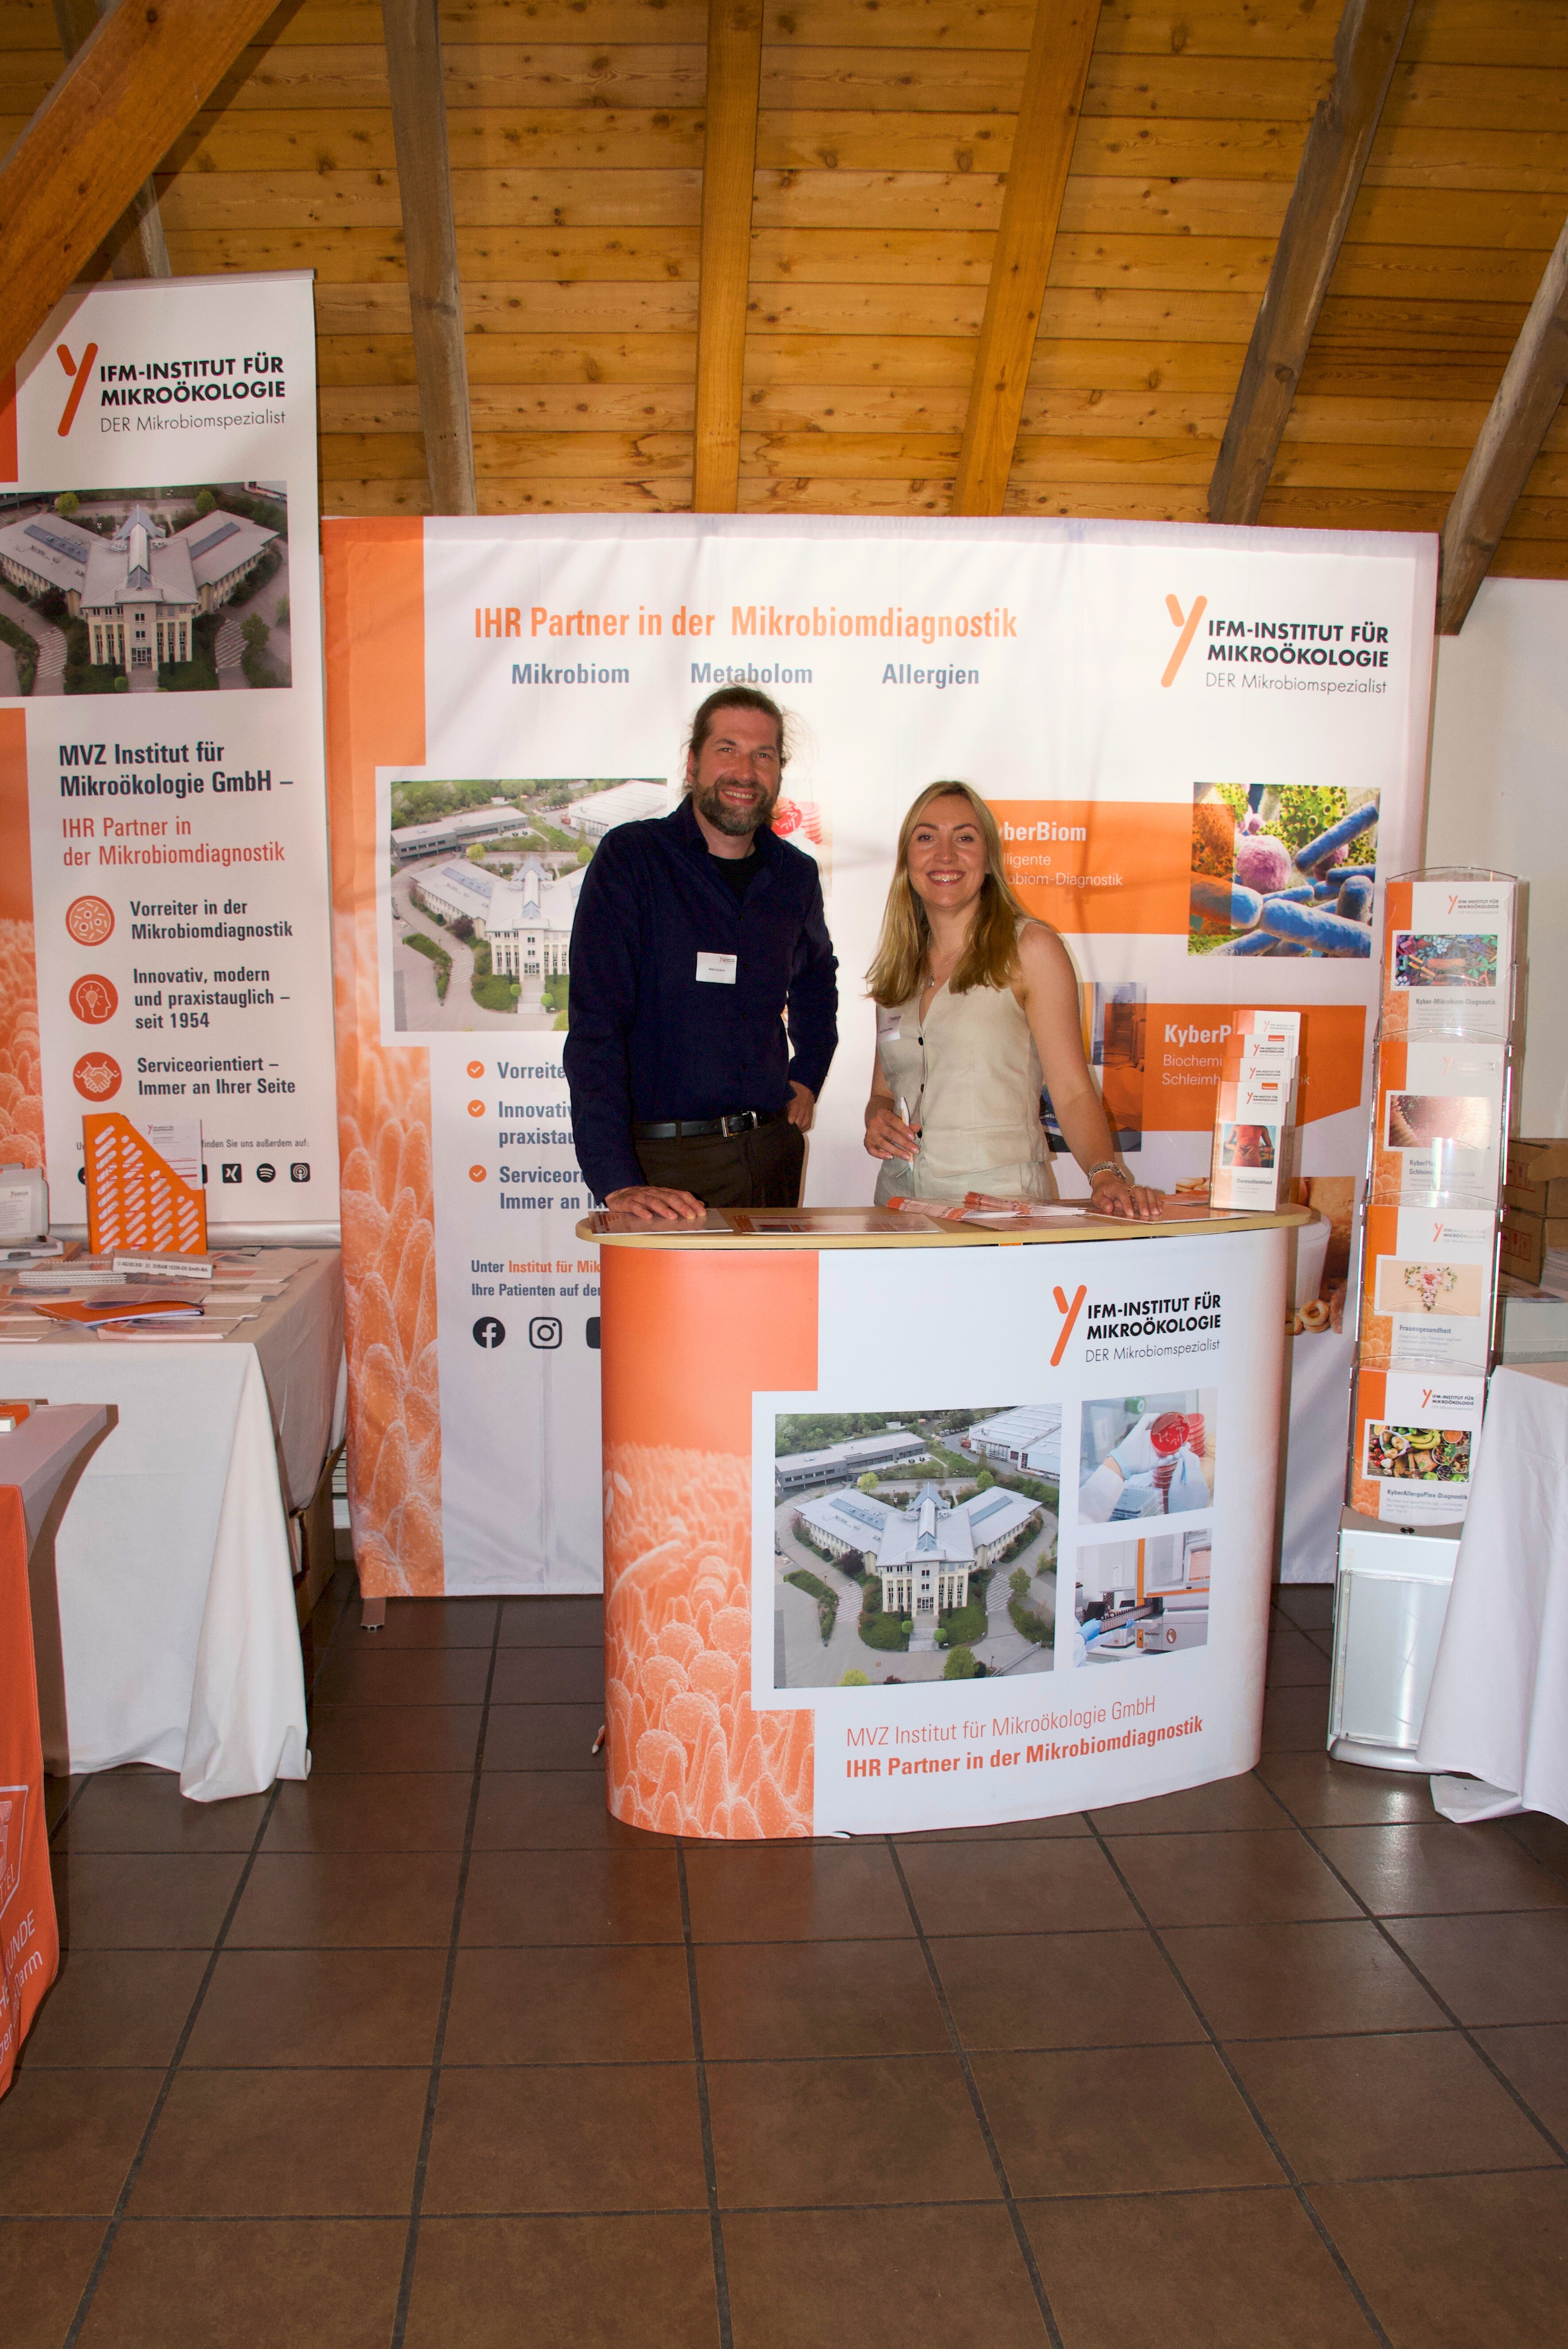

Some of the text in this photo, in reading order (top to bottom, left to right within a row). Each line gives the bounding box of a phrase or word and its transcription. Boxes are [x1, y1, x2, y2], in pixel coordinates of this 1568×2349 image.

[101, 352, 284, 382] IFM-INSTITUT FÜR
[101, 381, 285, 406] MIKROÖKOLOGIE
[101, 409, 285, 432] DER Mikrobiomspezialist
[476, 606, 1017, 644] IHR Partner in der Mikrobiomdiagnostik
[1209, 621, 1388, 643] IFM-INSTITUT FÜR
[1208, 643, 1388, 667] MIKROÖKOLOGIE
[512, 663, 978, 689] Mikrobiom Metabolom Allergien
[1206, 672, 1387, 695] DER Mikrobiomspezialist
[60, 742, 224, 766] MVZ Institut für
[61, 773, 204, 798] Mikroökologie
[213, 770, 271, 793] GmbH
[63, 816, 191, 838] IHR Partner in
[998, 822, 1086, 841] berBiom
[64, 842, 285, 867] der Mikrobiomdiagnostik
[1004, 853, 1051, 868] lligente
[1008, 872, 1122, 888] obiom-Diagnostik
[130, 899, 247, 916] Vorreiter in der
[132, 921, 293, 941] Mikrobiomdiagnostik
[134, 966, 269, 984] Innovativ, modern
[135, 991, 162, 1006] und
[168, 989, 274, 1009] praxistauglich
[136, 1012, 209, 1029] seit 1954
[1165, 1024, 1232, 1047] KyberP
[138, 1057, 263, 1073] Serviceorientiert
[497, 1062, 565, 1079] Vorreite
[1164, 1054, 1222, 1067] Biochemi
[139, 1078, 295, 1095] Immer an Ihrer Seite
[1162, 1073, 1220, 1085] Schleimh
[256, 1139, 292, 1147] außerdem
[295, 1138, 309, 1147] auf:
[499, 1127, 575, 1148] praxistau
[501, 1193, 553, 1209] Immer
[561, 1197, 579, 1209] an
[471, 1260, 601, 1273] Unter Institut für Mik
[472, 1283, 494, 1296] Ihre
[499, 1284, 555, 1296] Patienten
[560, 1284, 579, 1296] auf
[1088, 1291, 1220, 1321] IFM-INSTITUT FÜR
[1087, 1314, 1220, 1340] MIKROÖKOLOGIE
[1400, 1325, 1451, 1333] Frauengesundheit
[1086, 1338, 1220, 1362] DER Mikrobiomspezialist
[1387, 1489, 1468, 1500] KyberAllergoPlex-Diagnostik
[848, 1695, 1155, 1746] MVZ Institut für Mikroökologie GmbH
[847, 1715, 1202, 1777] IHR Partner in der Mikrobiomdiagnostik
